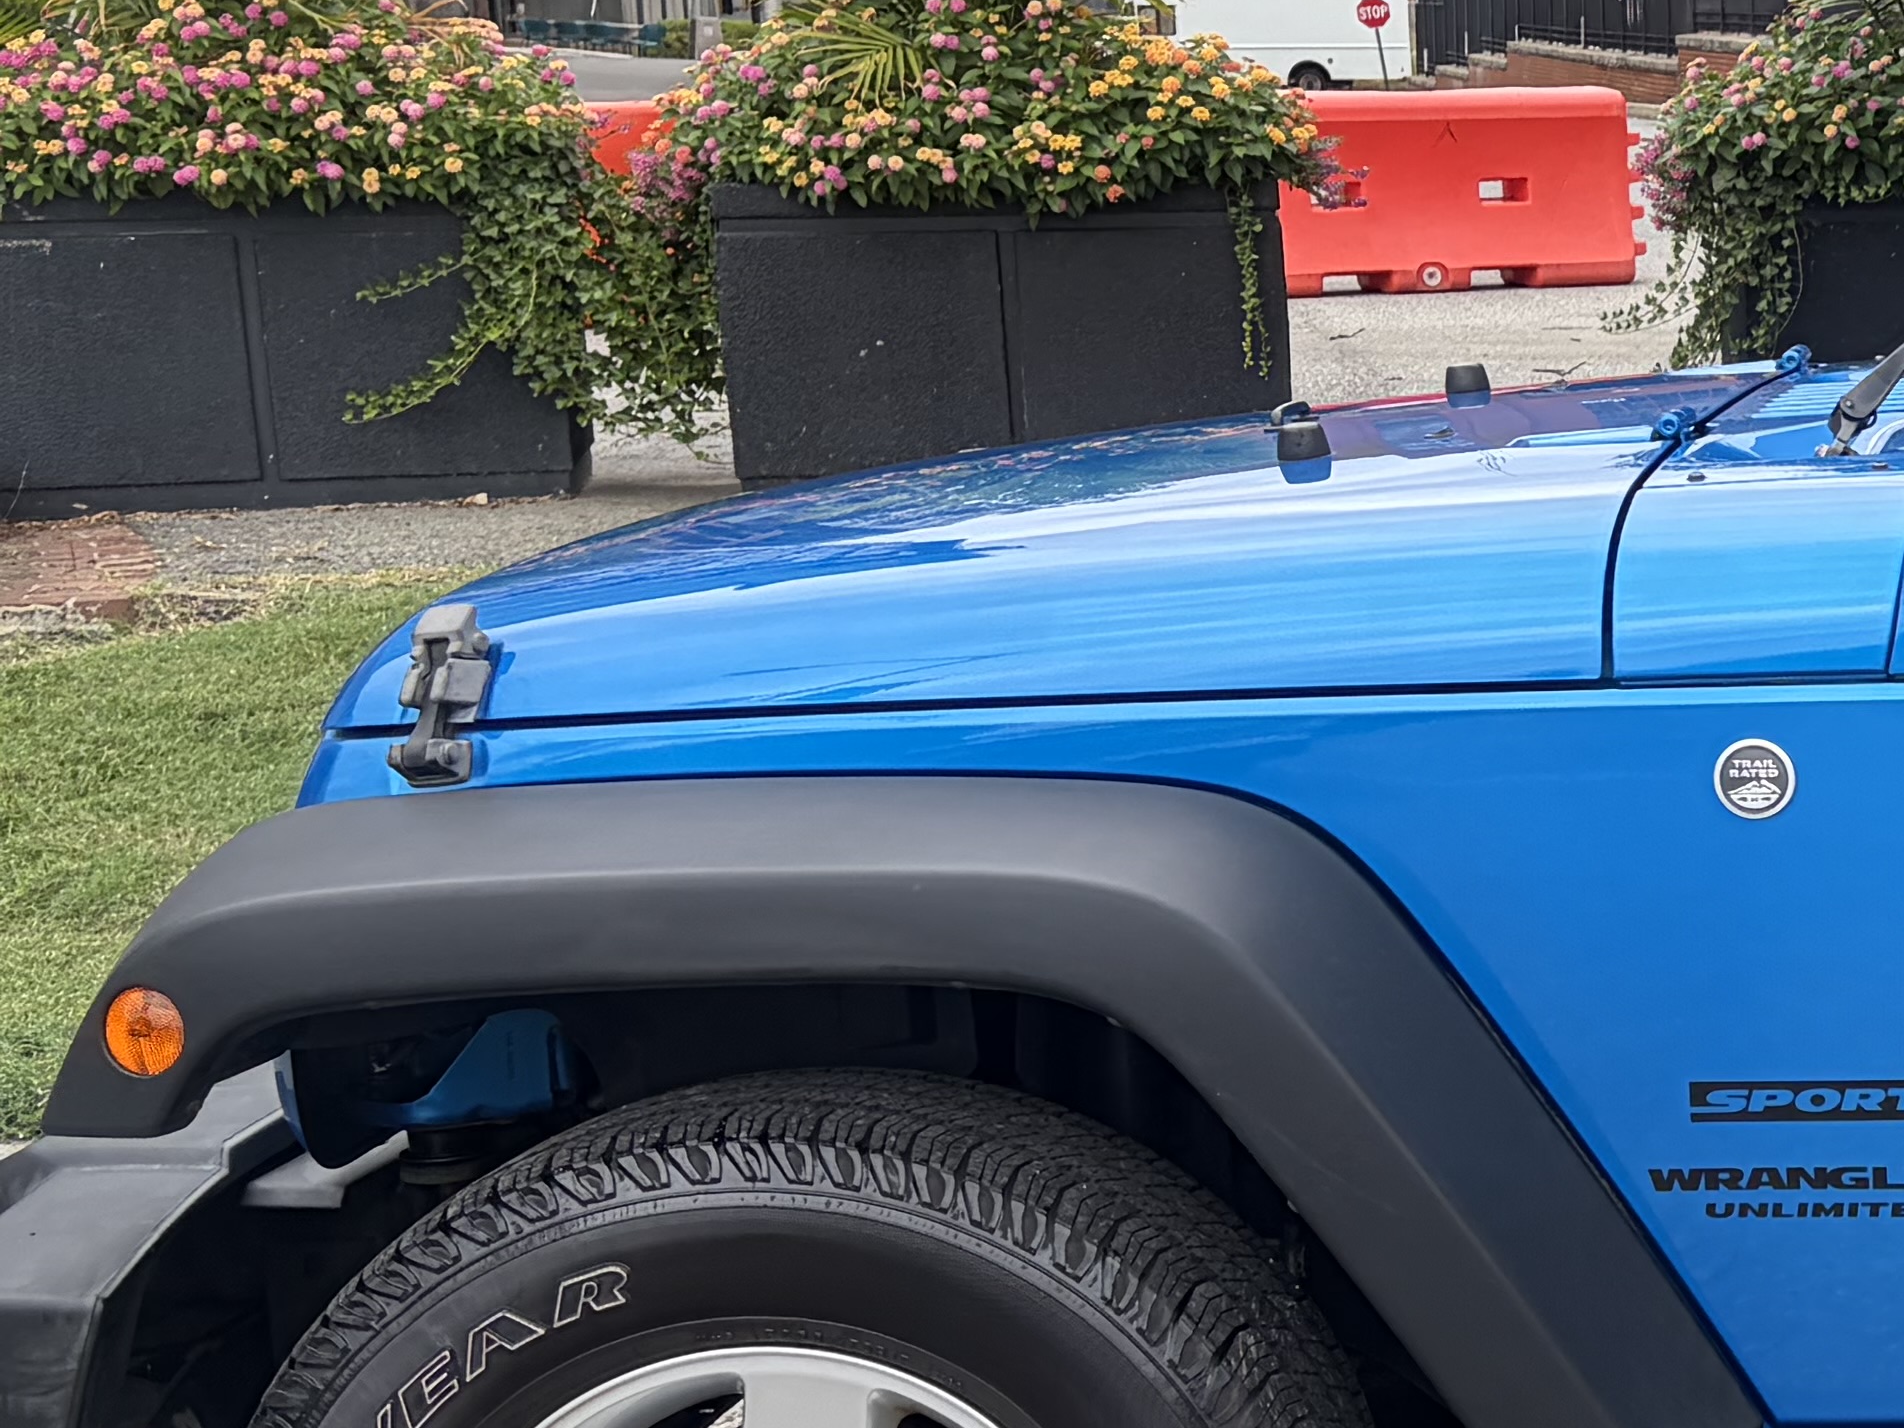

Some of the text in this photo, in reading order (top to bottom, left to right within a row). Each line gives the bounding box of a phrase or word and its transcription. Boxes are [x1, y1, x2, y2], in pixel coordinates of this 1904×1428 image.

[1359, 4, 1388, 20] STOP
[1732, 759, 1777, 768] TRAIL
[1729, 769, 1779, 778] RATED
